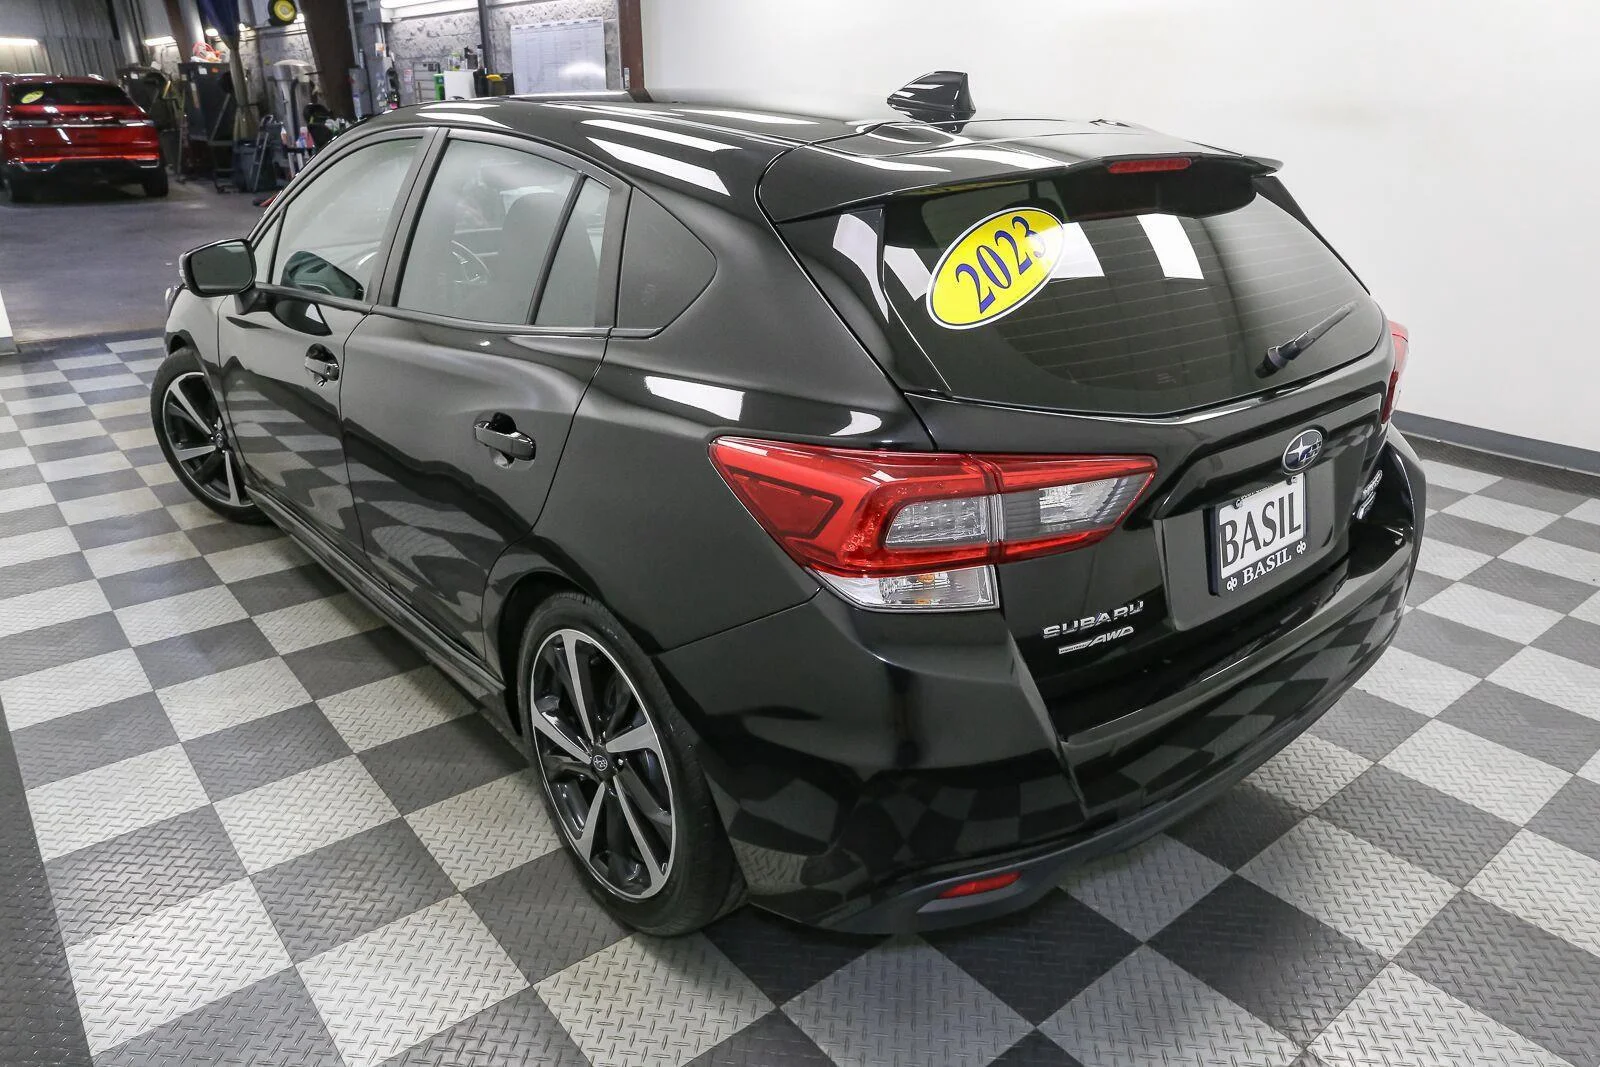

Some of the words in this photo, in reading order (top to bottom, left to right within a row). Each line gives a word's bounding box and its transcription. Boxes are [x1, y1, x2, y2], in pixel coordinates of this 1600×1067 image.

[955, 215, 1046, 314] 2023
[1220, 492, 1301, 569] BASIL
[1242, 547, 1292, 586] BASIL
[1043, 600, 1144, 639] SUBARU
[1089, 625, 1134, 648] AWD
